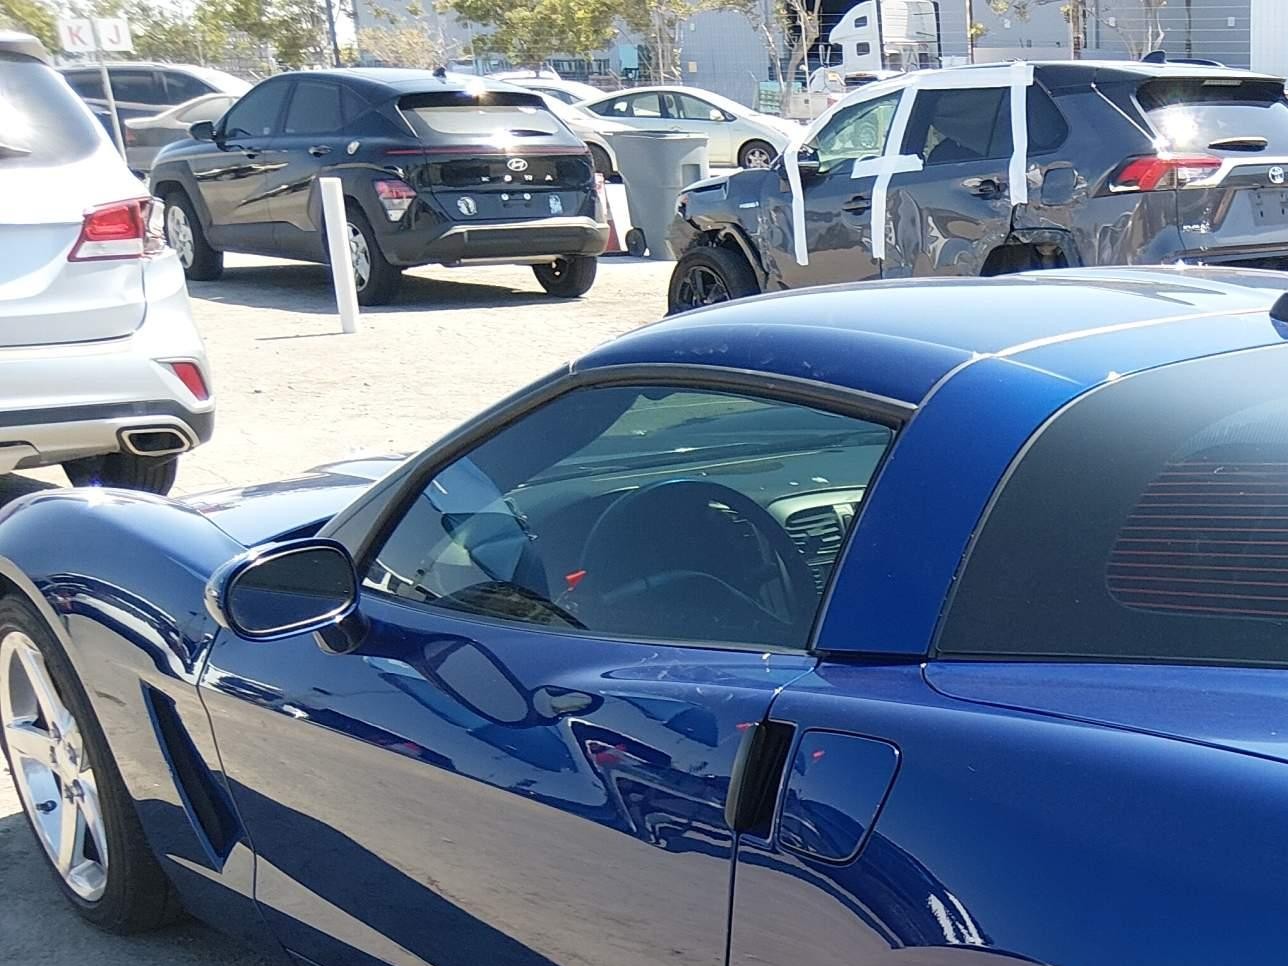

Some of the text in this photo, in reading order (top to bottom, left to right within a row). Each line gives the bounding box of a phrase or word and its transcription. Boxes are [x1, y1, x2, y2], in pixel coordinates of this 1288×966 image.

[67, 25, 88, 46] K
[107, 24, 121, 45] J
[481, 174, 553, 182] KONA
